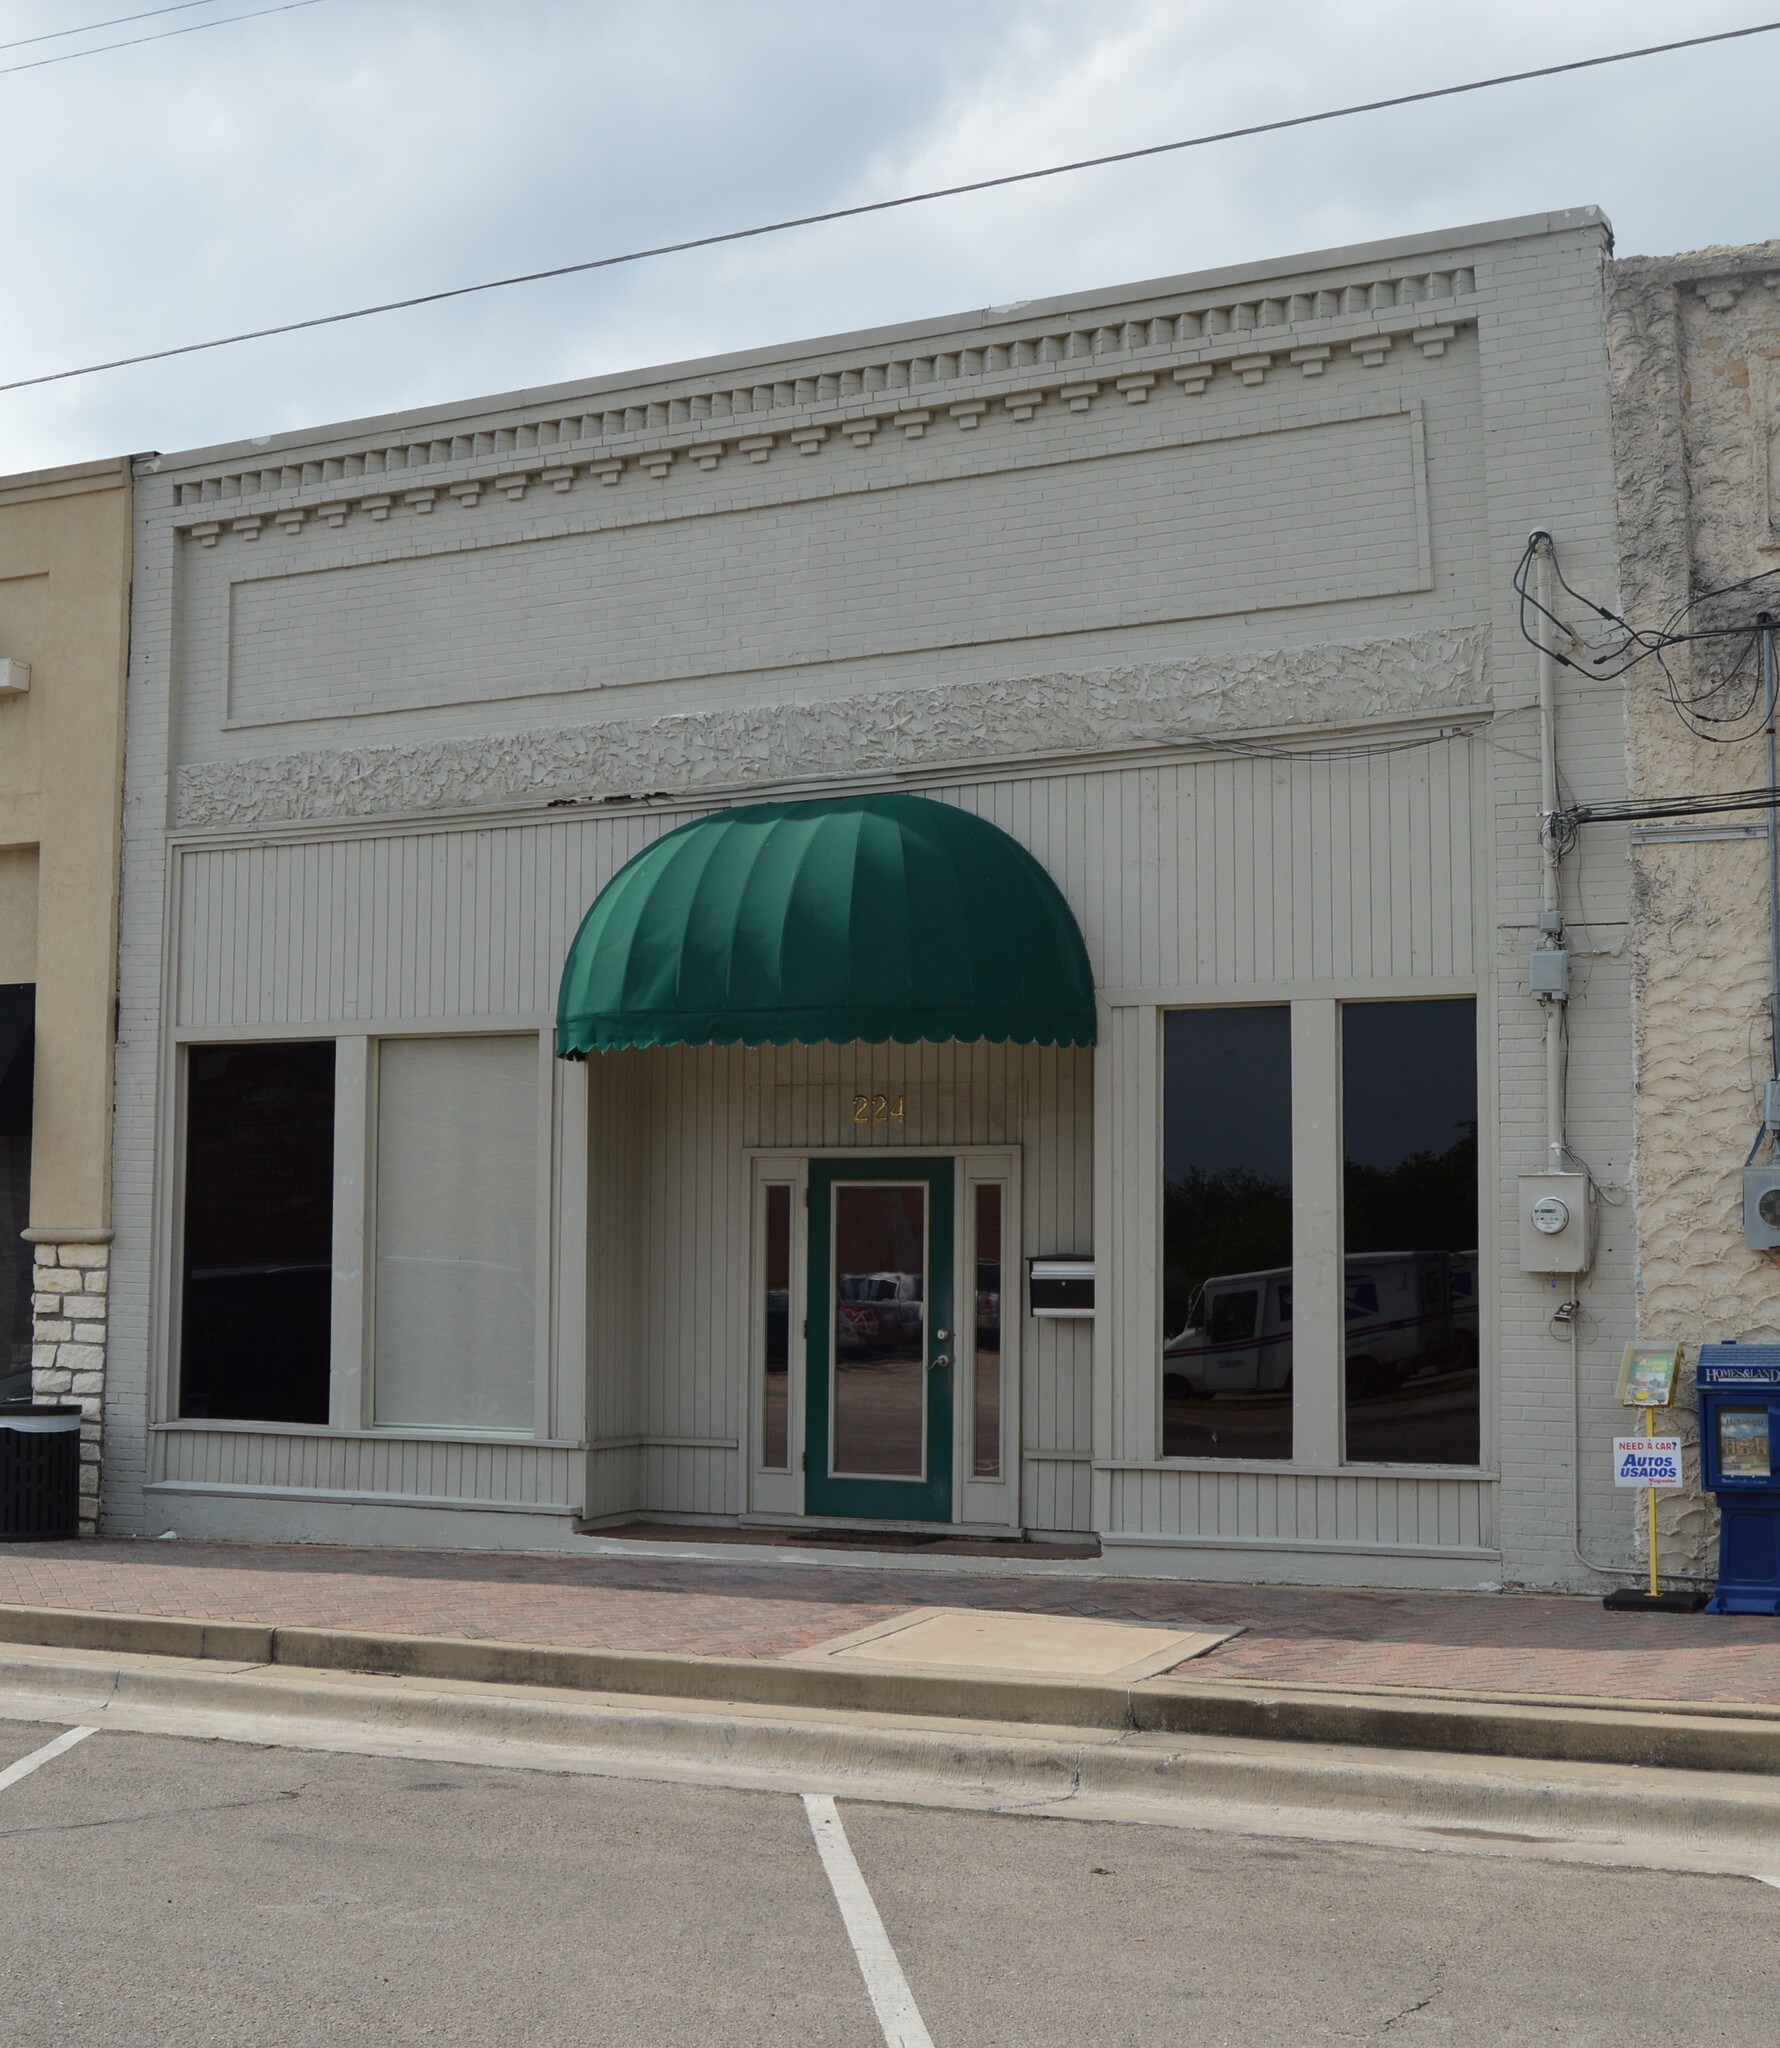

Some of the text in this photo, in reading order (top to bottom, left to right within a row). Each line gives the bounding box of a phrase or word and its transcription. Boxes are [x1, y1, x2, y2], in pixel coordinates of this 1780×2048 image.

[852, 1095, 905, 1124] 224
[1619, 1441, 1677, 1450] NEED A CAR?
[1623, 1453, 1673, 1467] AUTOS
[1620, 1467, 1677, 1478] USADOS
